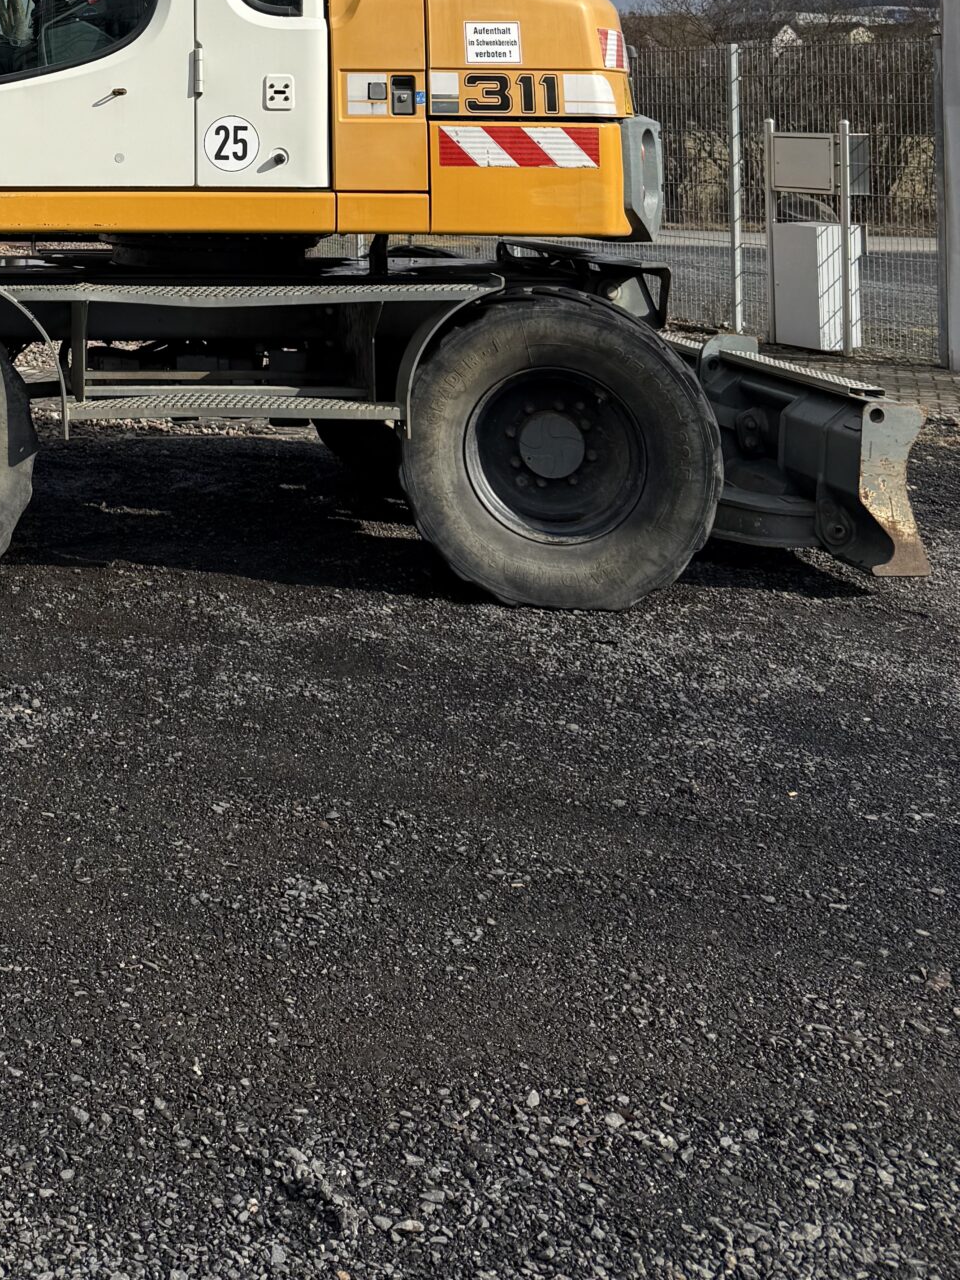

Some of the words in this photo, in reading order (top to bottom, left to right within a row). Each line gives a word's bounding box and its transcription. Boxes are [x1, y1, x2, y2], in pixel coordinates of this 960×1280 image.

[473, 26, 512, 35] Aufenthalt
[476, 38, 518, 47] Schwenkbereich
[474, 50, 507, 58] verboten
[464, 73, 560, 114] 311
[214, 125, 248, 161] 25
